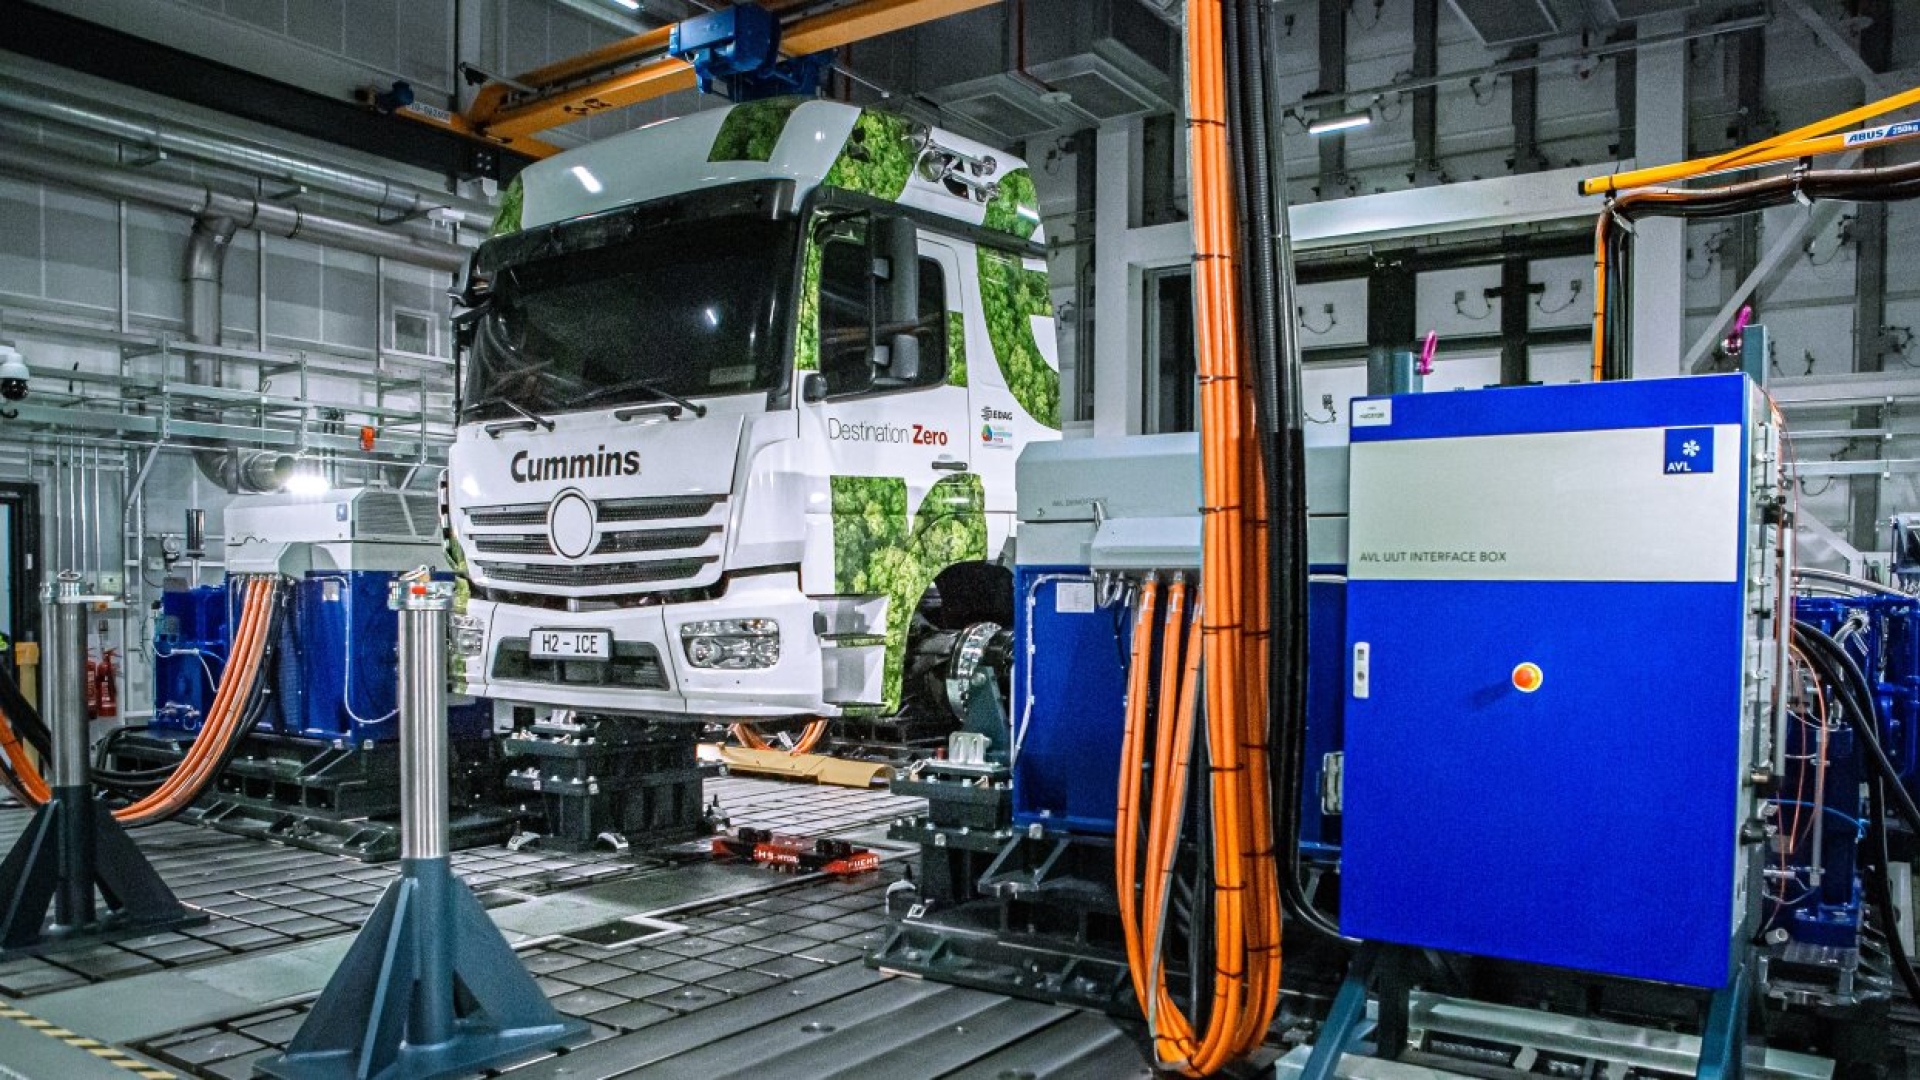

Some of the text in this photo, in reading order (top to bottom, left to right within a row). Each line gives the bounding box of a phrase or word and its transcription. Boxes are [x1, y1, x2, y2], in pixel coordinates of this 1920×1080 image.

[1849, 130, 1884, 142] ABUS
[993, 409, 1013, 421] EDAG
[828, 417, 948, 446] Destination Zero
[510, 444, 641, 483] Cummins
[1667, 461, 1692, 472] AVL
[1360, 551, 1507, 562] AVL UUT INTERFACE BOX
[542, 633, 559, 653] H2
[574, 634, 598, 654] ICE
